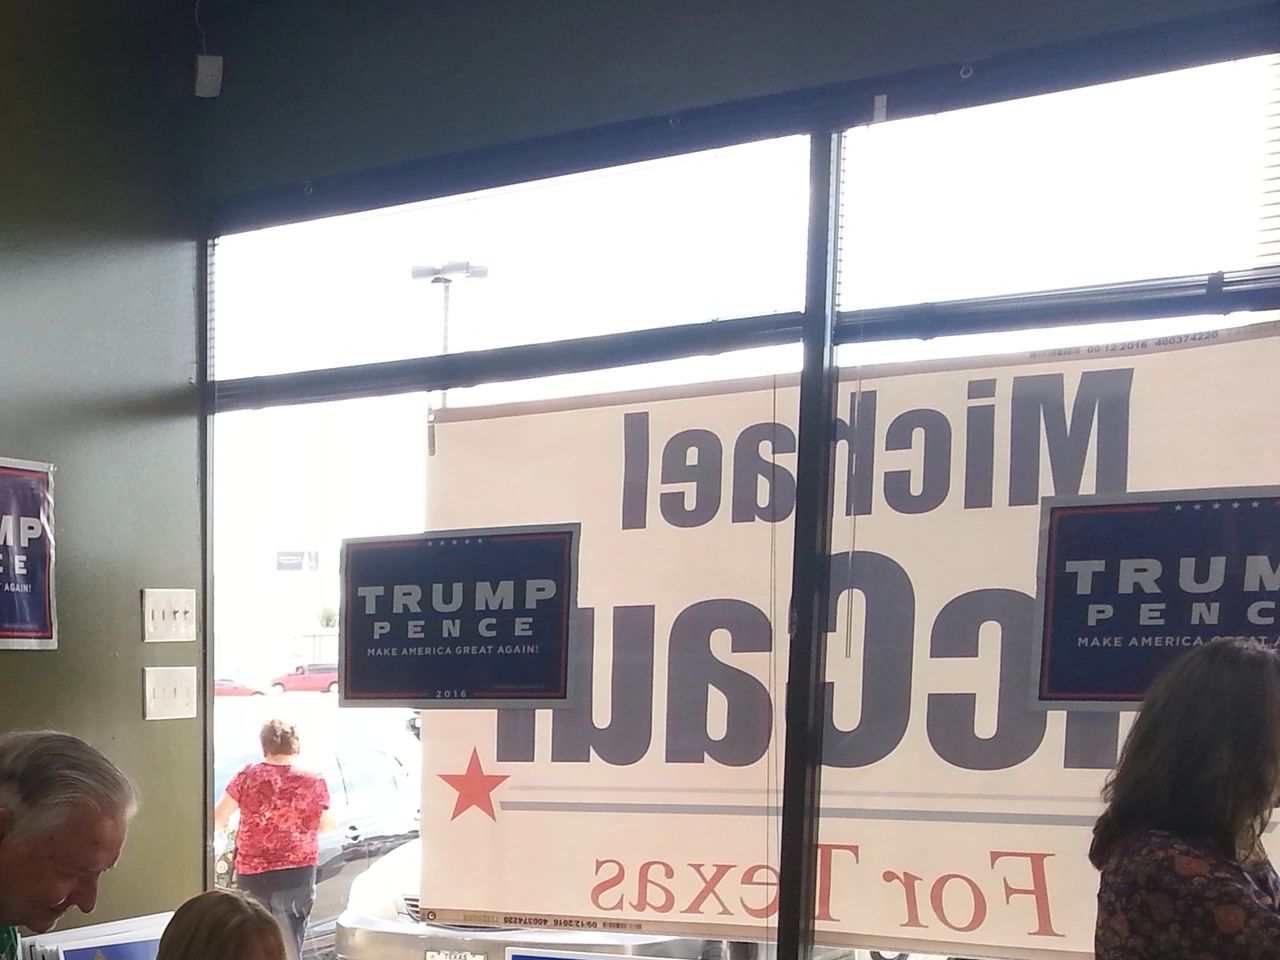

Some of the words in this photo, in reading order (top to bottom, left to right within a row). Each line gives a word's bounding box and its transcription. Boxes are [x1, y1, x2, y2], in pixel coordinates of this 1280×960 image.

[4, 582, 32, 593] AGAIN!
[357, 579, 557, 614] TRUMP
[373, 617, 534, 639] PENCE
[1077, 637, 1122, 647] MAKE
[1128, 636, 1203, 647] AMERICA
[367, 647, 398, 657] MAKE
[401, 646, 452, 656] AMERICA
[455, 645, 493, 655] GREAT
[496, 645, 539, 654] AGAIN!
[435, 689, 467, 698] 2016
